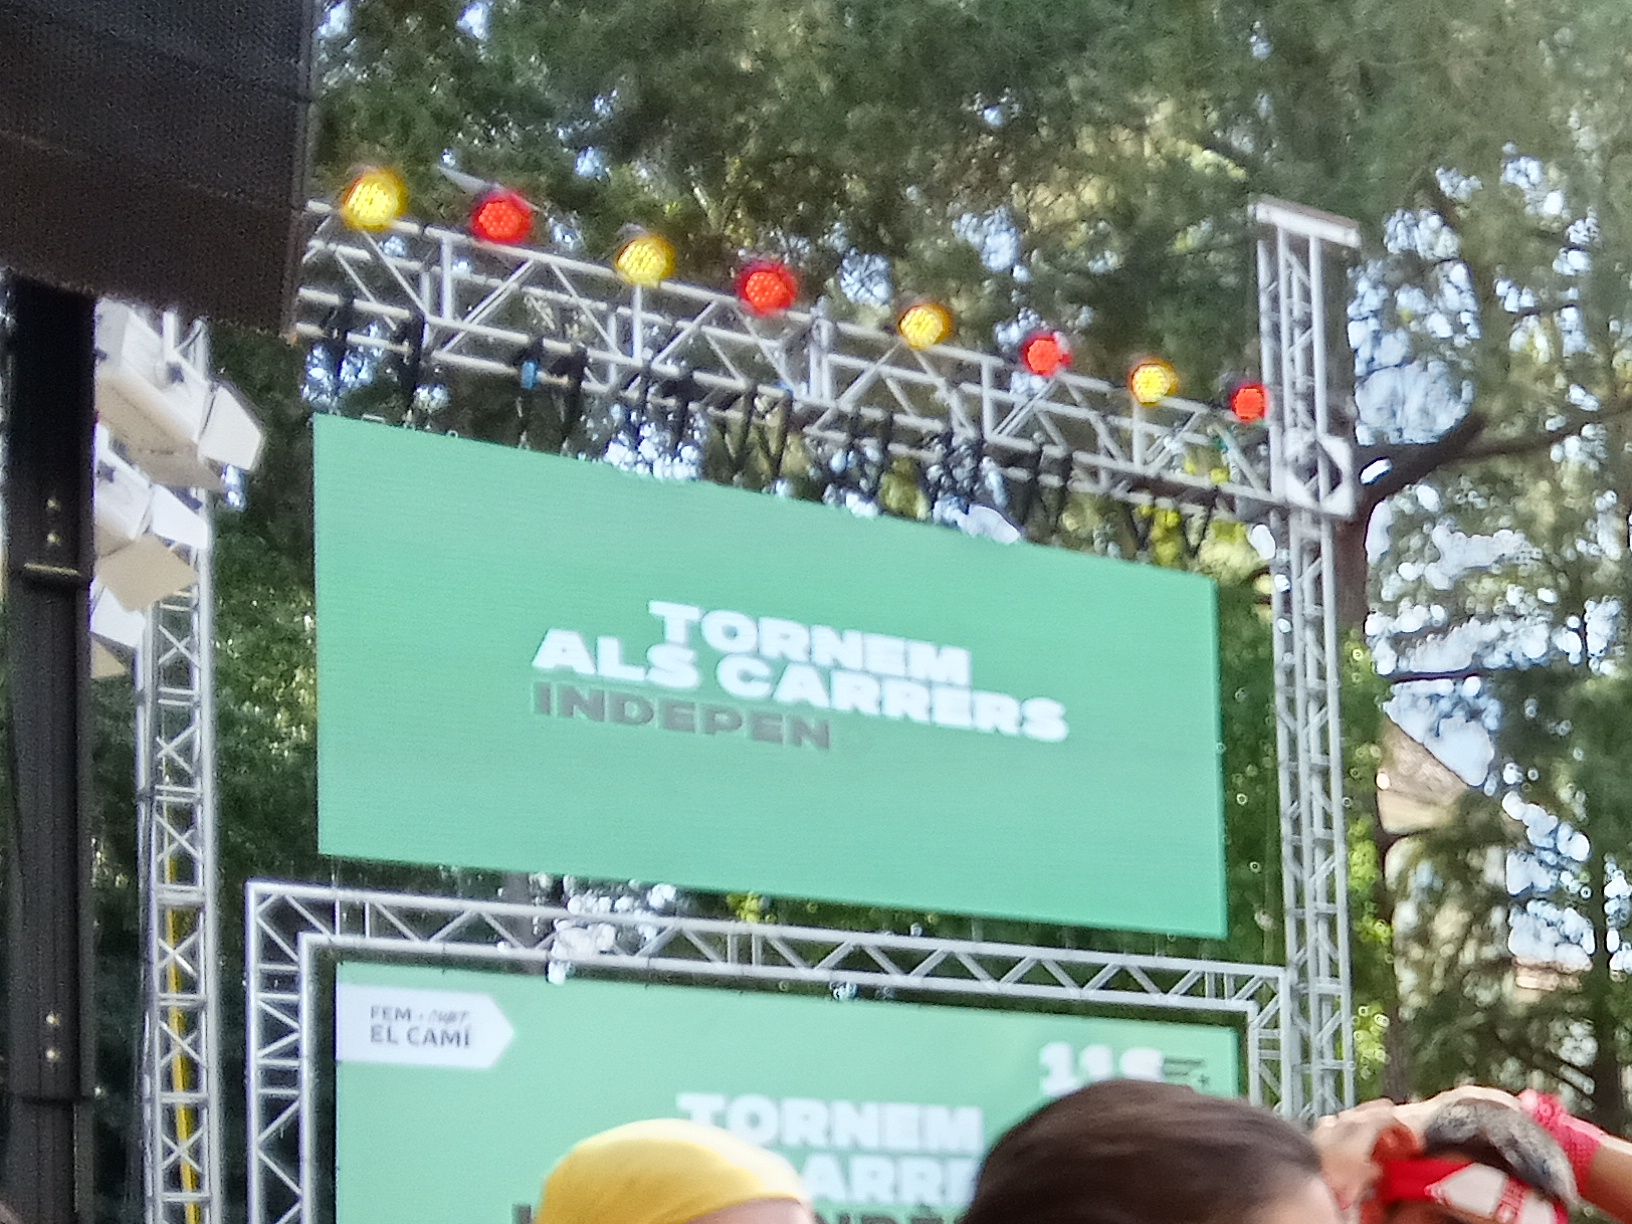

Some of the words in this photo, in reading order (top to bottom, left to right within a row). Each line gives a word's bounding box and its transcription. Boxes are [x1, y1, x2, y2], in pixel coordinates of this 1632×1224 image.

[649, 600, 973, 686] TORNEM
[531, 628, 703, 690] ALS
[715, 652, 1070, 743] CARRERS
[532, 681, 831, 752] INDEPEN
[370, 1006, 412, 1022] FEM
[370, 1024, 398, 1044] EL
[677, 1093, 984, 1152] TORNEM
